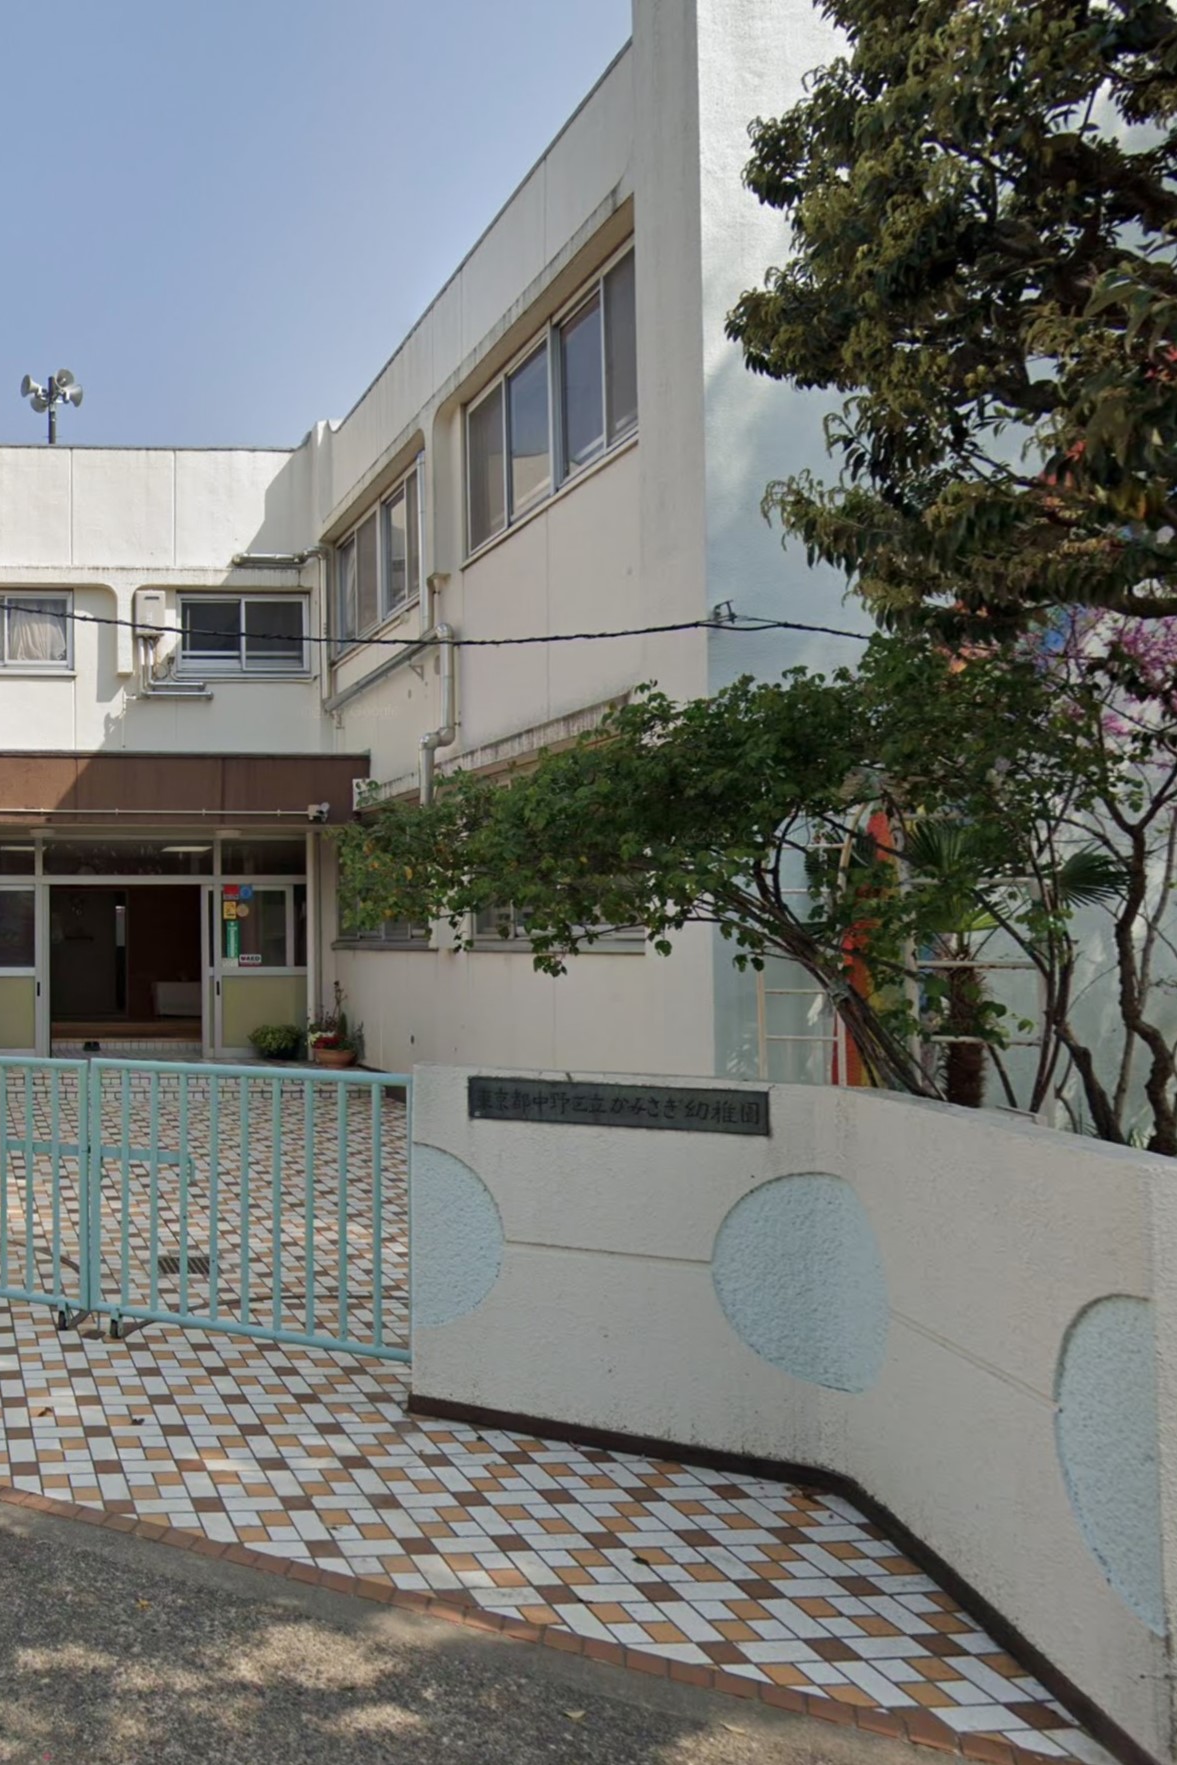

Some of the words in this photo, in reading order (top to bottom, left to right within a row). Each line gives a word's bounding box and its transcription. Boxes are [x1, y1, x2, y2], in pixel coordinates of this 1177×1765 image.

[476, 1087, 761, 1125] 東京都中野区立かみさぎ幼稚園
